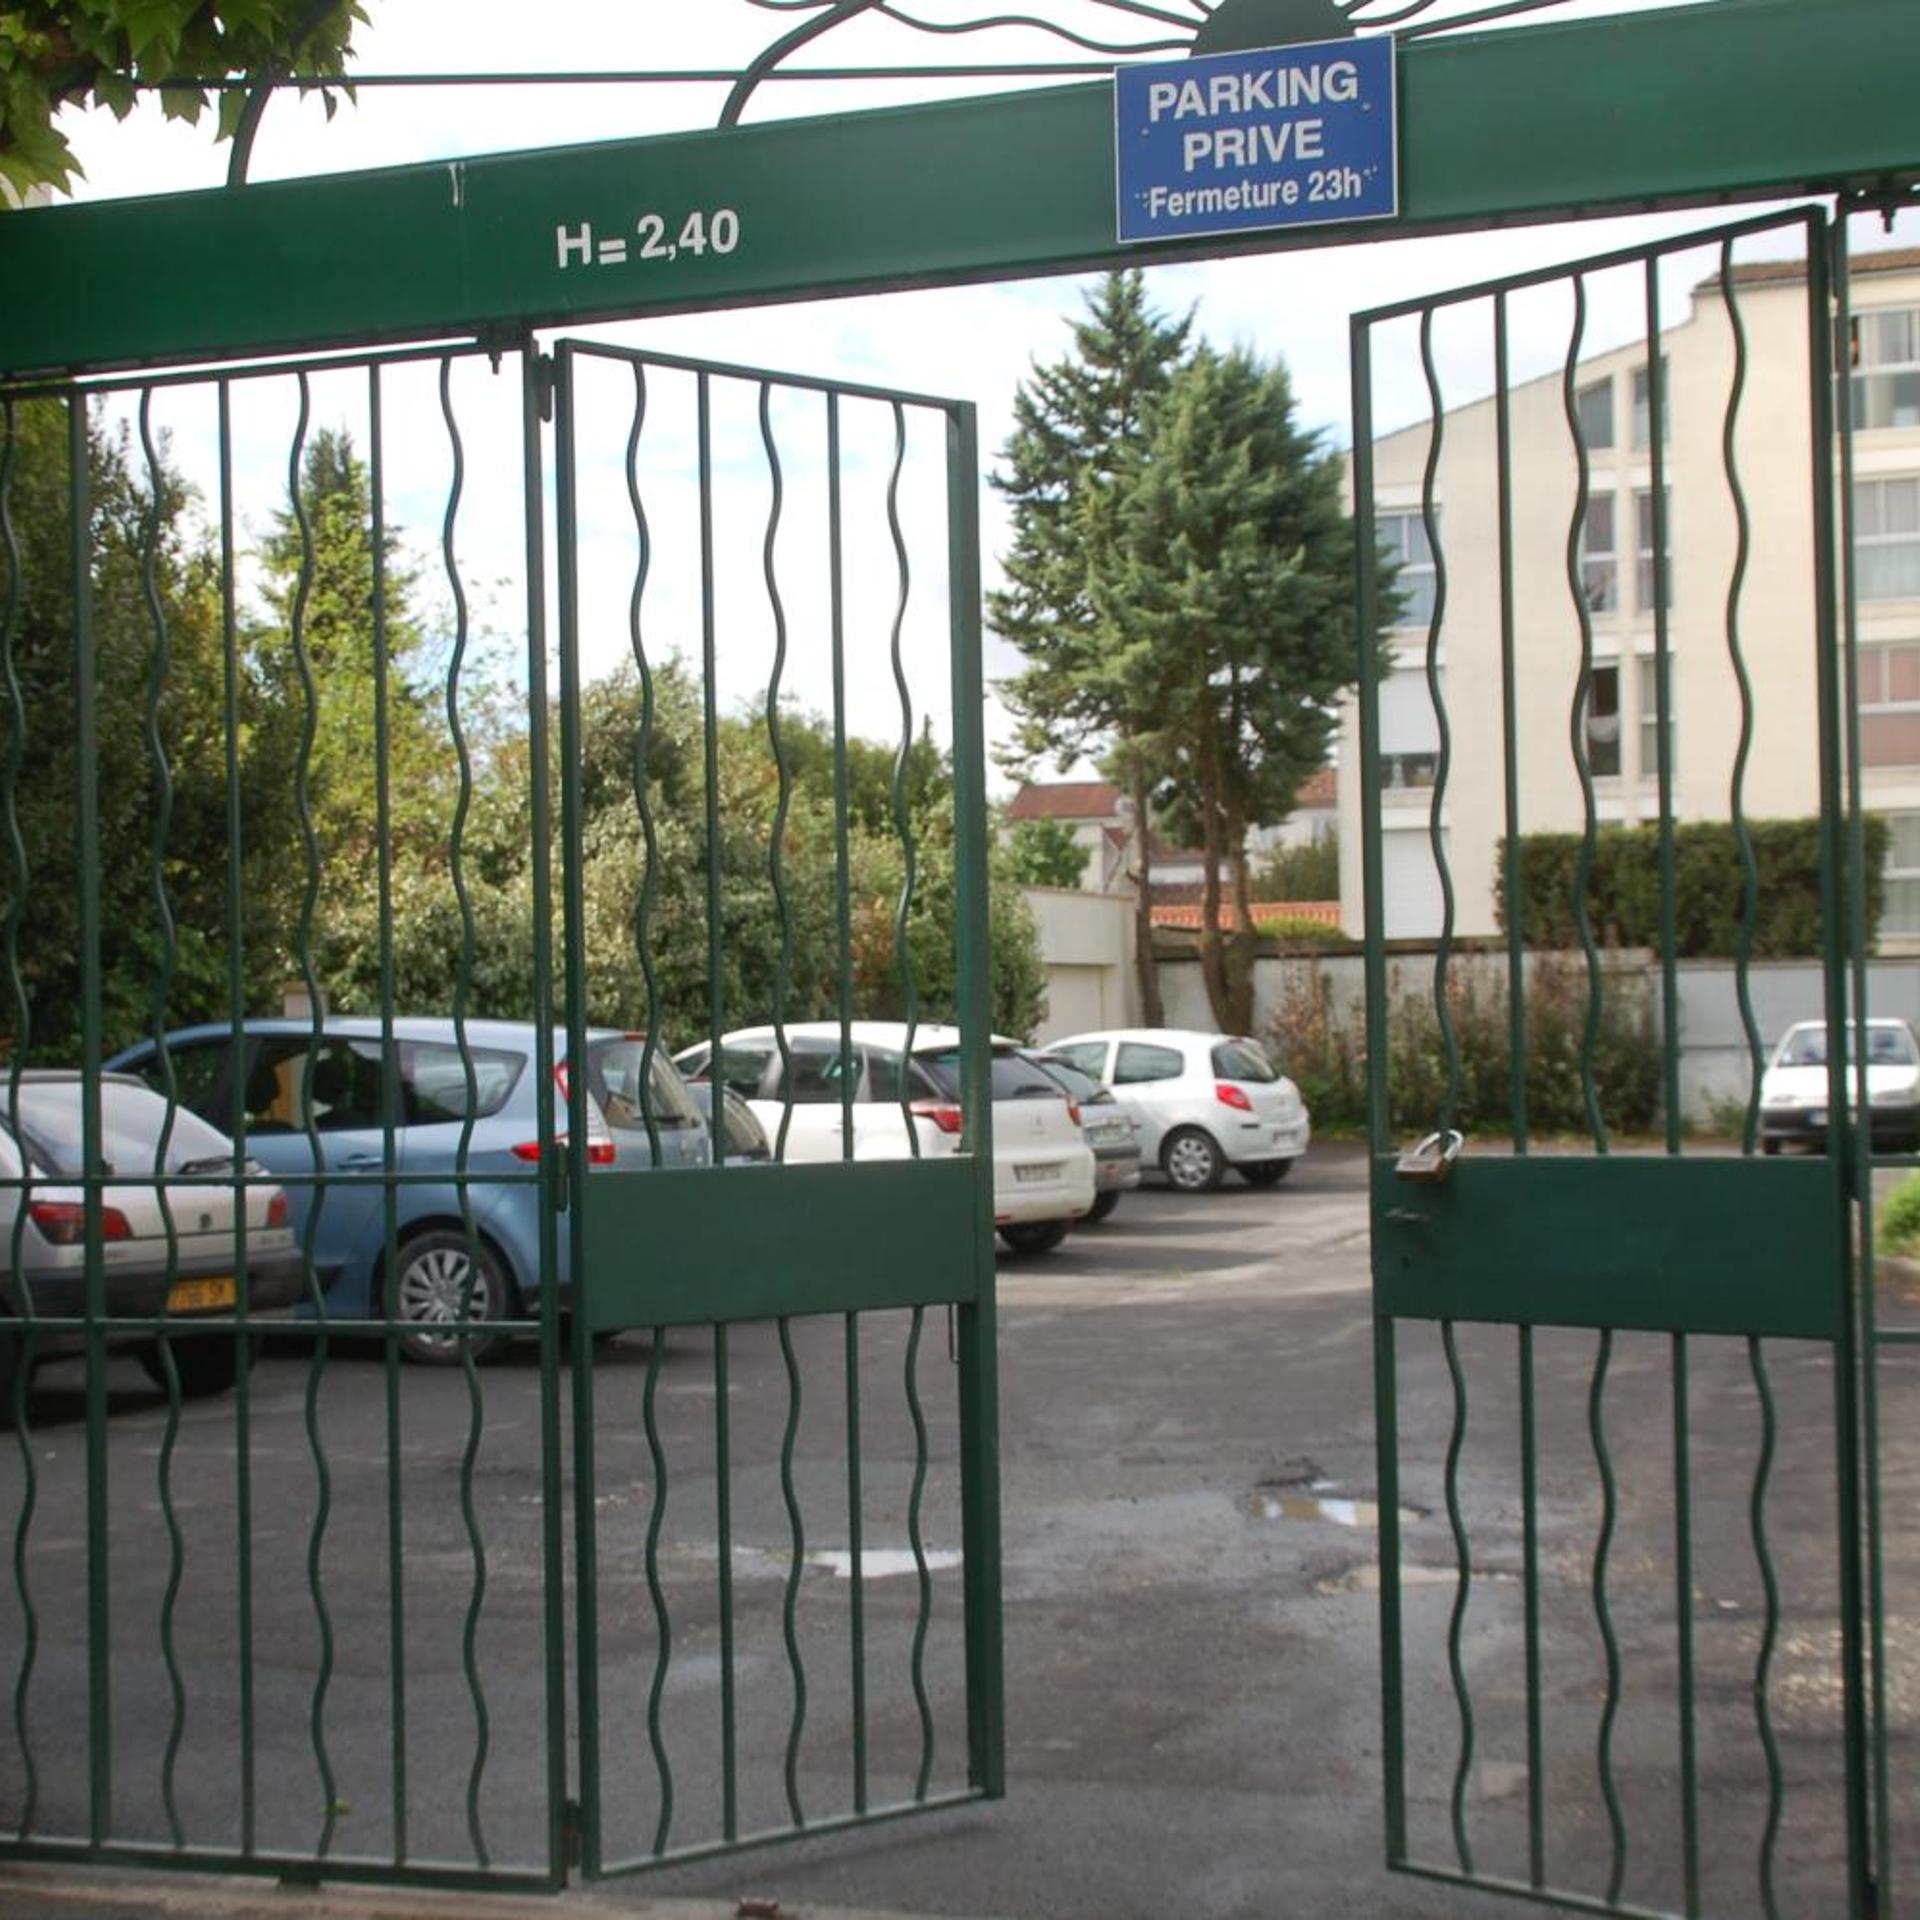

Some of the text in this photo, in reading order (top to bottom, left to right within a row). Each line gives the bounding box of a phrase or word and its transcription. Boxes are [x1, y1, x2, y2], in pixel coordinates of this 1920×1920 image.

[1149, 61, 1358, 122] PARKING
[1184, 118, 1325, 172] PRIVE
[1150, 166, 1362, 219] Fermeture 23h
[637, 209, 740, 262] 2,40
